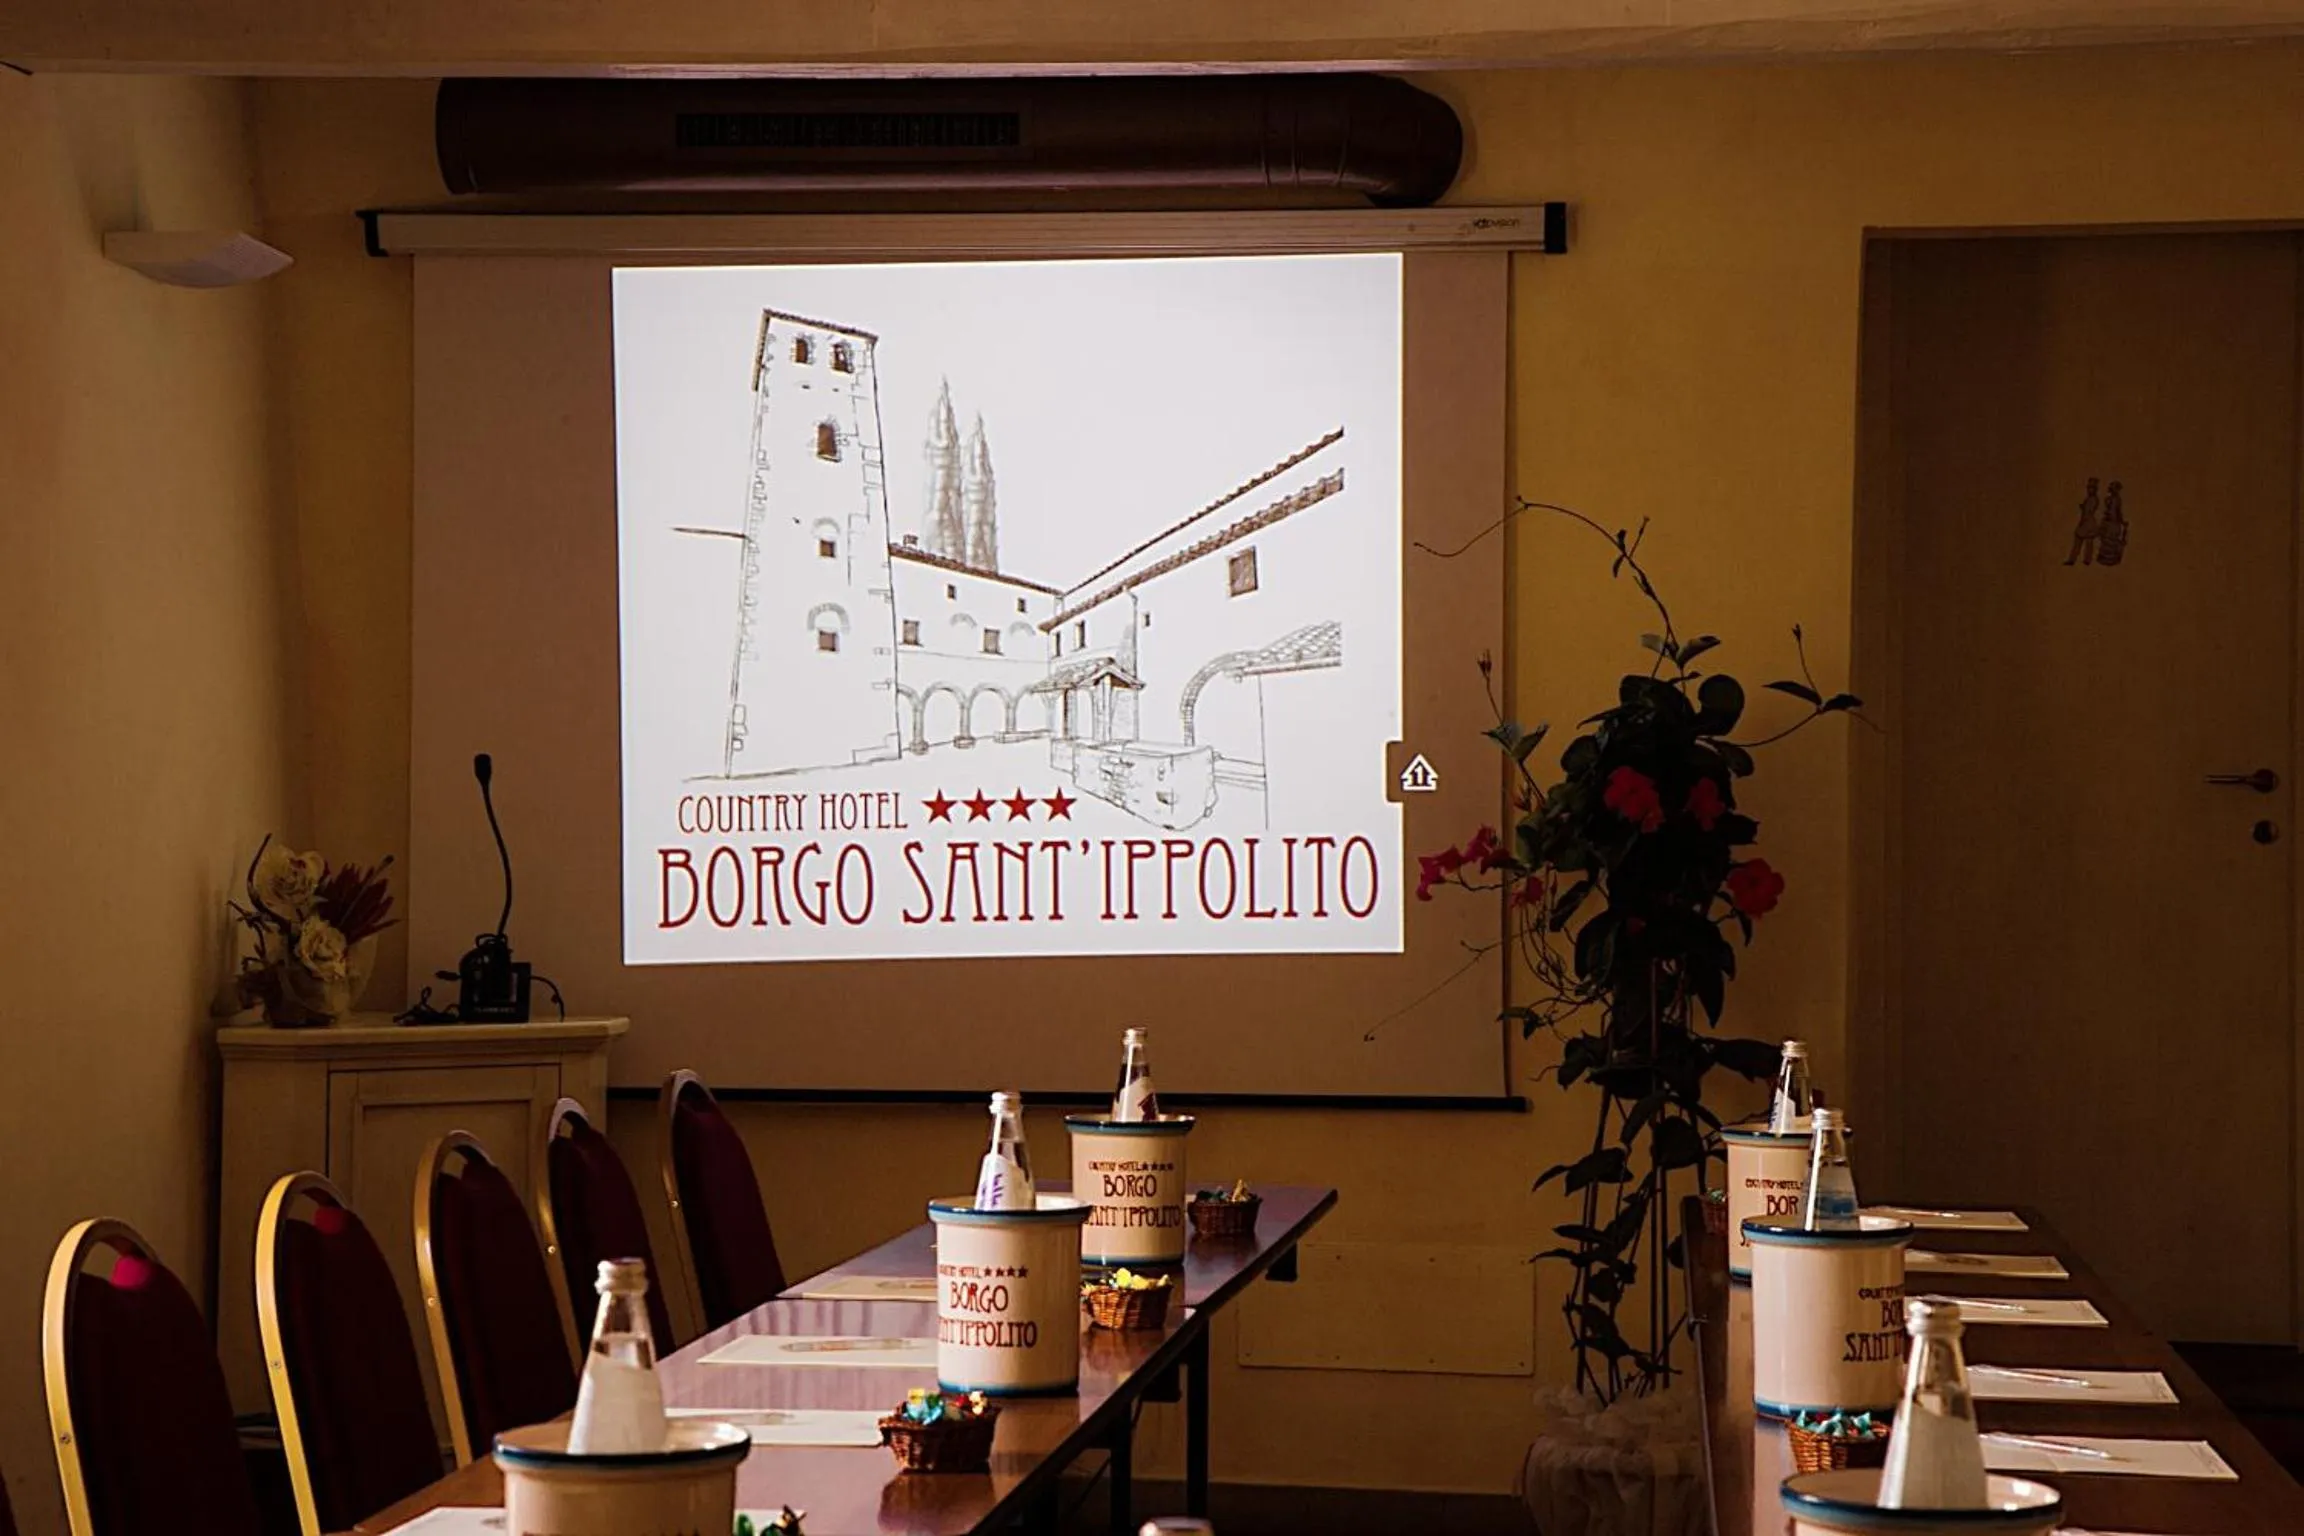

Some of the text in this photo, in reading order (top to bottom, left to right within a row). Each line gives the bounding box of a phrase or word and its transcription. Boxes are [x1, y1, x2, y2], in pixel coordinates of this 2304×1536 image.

[678, 792, 909, 834] COUNTRY HOTEL
[657, 834, 1380, 929] BORGO SANT'IPPOLITO
[1102, 1174, 1157, 1198] BORGO
[1087, 1204, 1181, 1229] ANT'IPPOLITO
[1766, 1194, 1799, 1216] BOR
[950, 1280, 1009, 1314] BORGO
